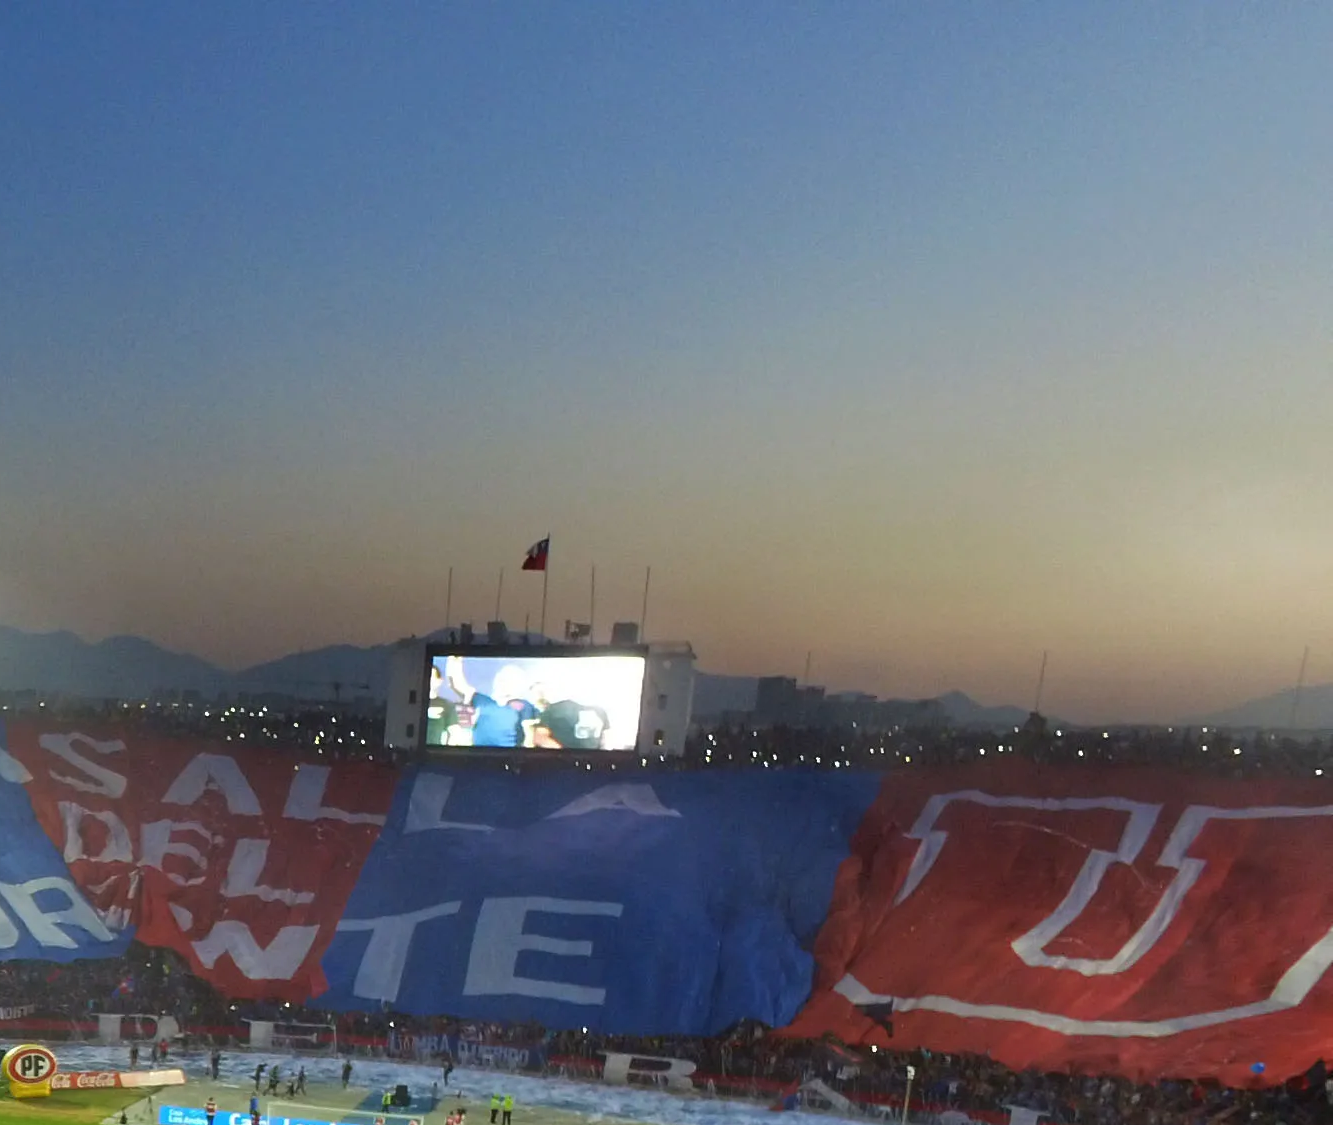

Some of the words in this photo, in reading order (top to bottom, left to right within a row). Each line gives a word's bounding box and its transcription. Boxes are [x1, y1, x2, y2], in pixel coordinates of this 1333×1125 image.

[161, 752, 683, 834] ALLA
[57, 801, 315, 903] DEL
[20, 1055, 46, 1077] PF
